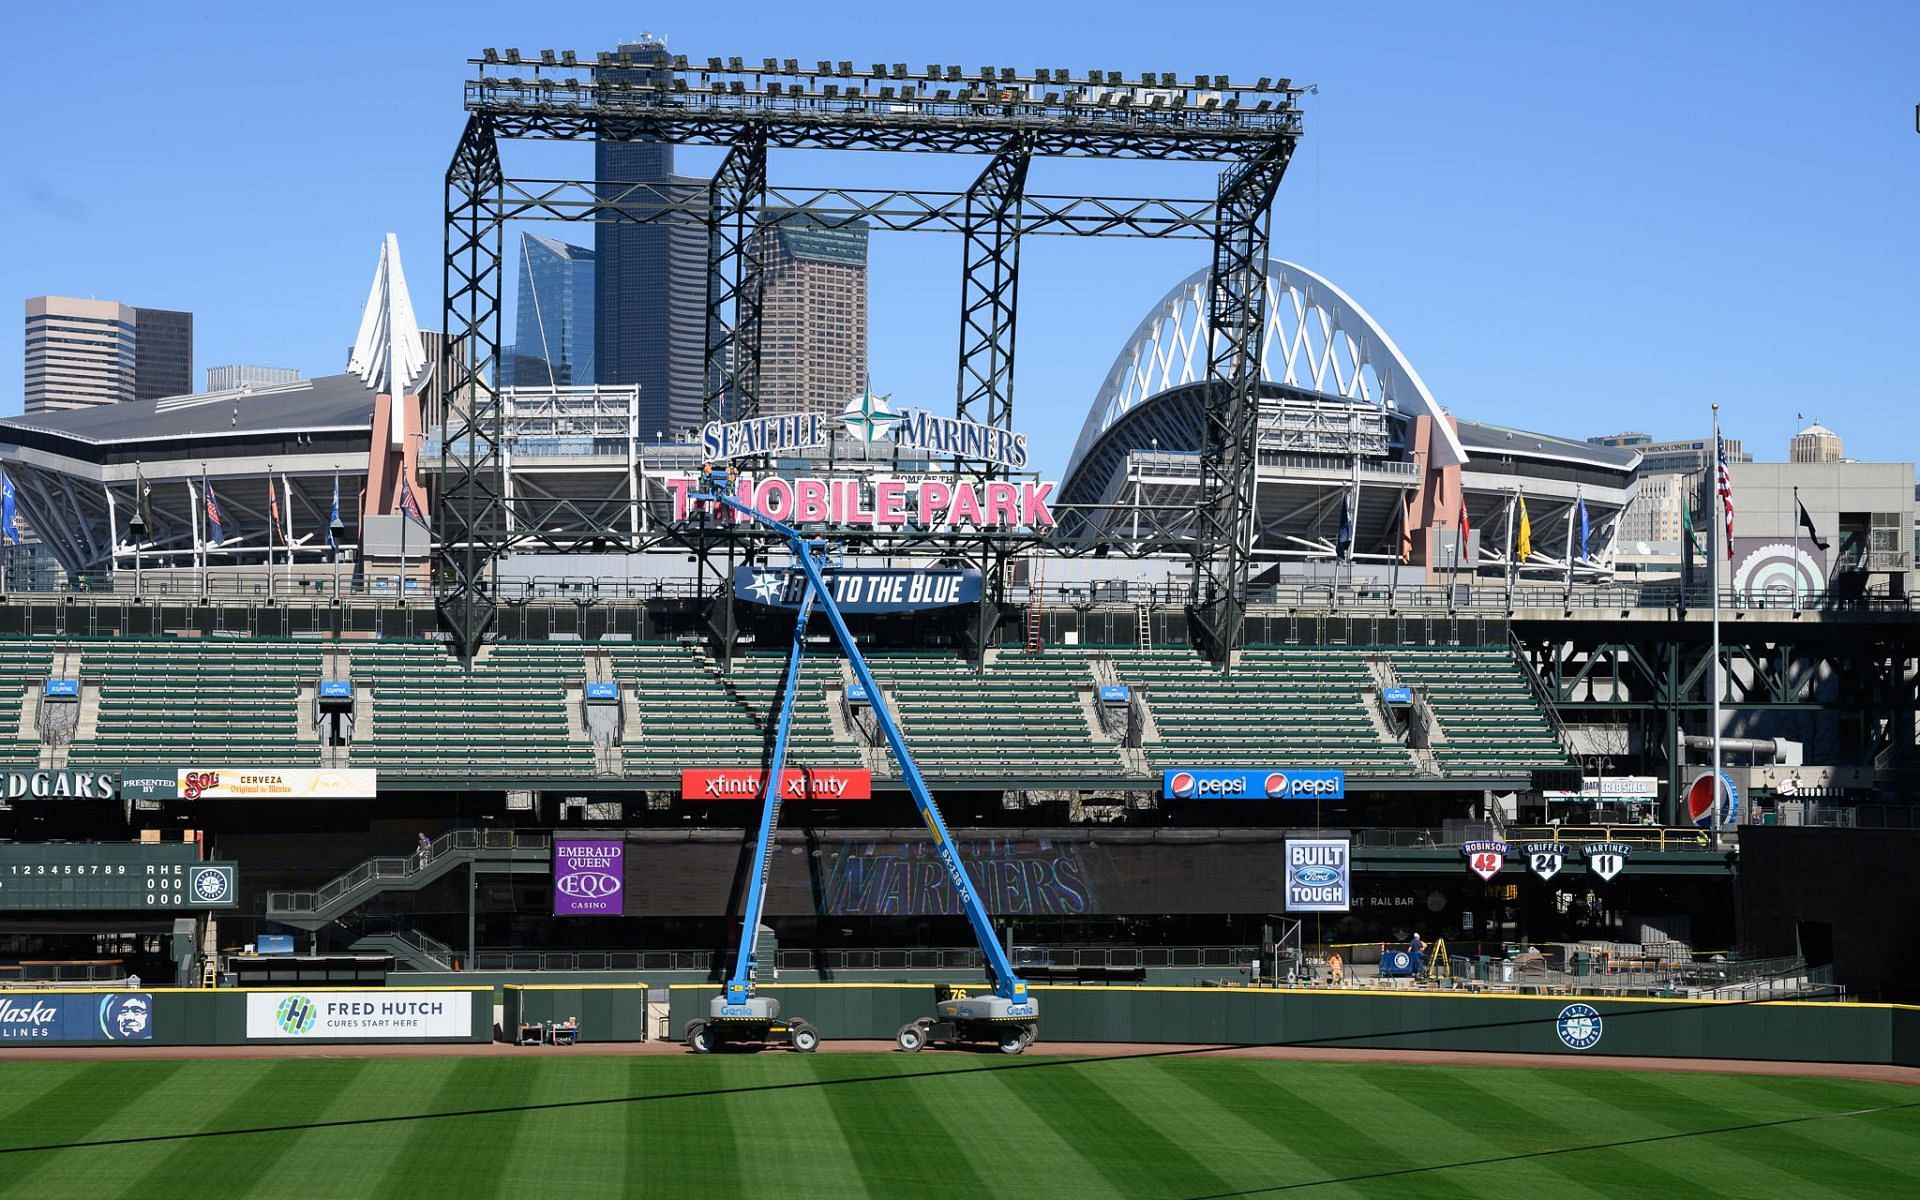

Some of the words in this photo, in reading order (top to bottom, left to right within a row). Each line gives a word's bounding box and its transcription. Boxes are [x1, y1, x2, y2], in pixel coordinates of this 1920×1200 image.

[702, 411, 827, 464] SEATTLE
[895, 408, 1028, 469] MARINERS
[1671, 443, 1690, 451] CENTER
[917, 478, 1059, 528] PARK
[836, 576, 859, 603] TO
[866, 576, 907, 603] THE
[908, 573, 964, 603] BLUE
[0, 771, 114, 799] DGAR'S
[123, 779, 176, 788] PRESENTED
[184, 772, 219, 800] SOL
[240, 776, 282, 784] CERVEZA
[705, 775, 766, 797] xfinity
[787, 775, 849, 797] xfinity
[1198, 776, 1247, 796] pepsi
[1291, 776, 1339, 796] pepsi
[1601, 783, 1621, 794] CRAB
[1623, 783, 1648, 794] SHACK
[558, 846, 621, 858] EMERALD
[1466, 842, 1507, 853] ROBINSON
[1528, 843, 1564, 853] GRIFFEY
[1585, 843, 1629, 855] MARTINEZ
[1292, 847, 1343, 865] BUILT
[1474, 853, 1496, 872] 42
[12, 866, 17, 874] 1
[23, 866, 31, 874] 2
[37, 866, 44, 874] 3
[51, 866, 58, 874] 4
[64, 866, 71, 874] 5
[78, 866, 85, 874] 6
[91, 866, 98, 874] 7
[105, 866, 111, 874] 8
[118, 866, 125, 874] 9
[147, 865, 155, 874] R
[161, 865, 168, 874] H
[174, 865, 182, 874] E
[567, 857, 611, 871] QUEEN
[1535, 854, 1557, 873] 24
[1600, 855, 1614, 874] 11
[941, 848, 963, 886] SX-135
[959, 885, 971, 903] XC
[1304, 870, 1330, 881] Ford
[566, 874, 615, 899] EQC
[1292, 887, 1343, 902] TOUGH
[1370, 897, 1392, 906] RAIL
[1394, 897, 1415, 906] BAR
[0, 999, 57, 1026] laska
[327, 1002, 375, 1015] FRED
[382, 1002, 443, 1015] HUTCH
[720, 1005, 753, 1016] Genie
[1006, 1005, 1033, 1016] Genie
[327, 1019, 358, 1027] CURES
[362, 1019, 389, 1027] START
[393, 1019, 418, 1027] HERE
[4, 1028, 48, 1037] LINES
